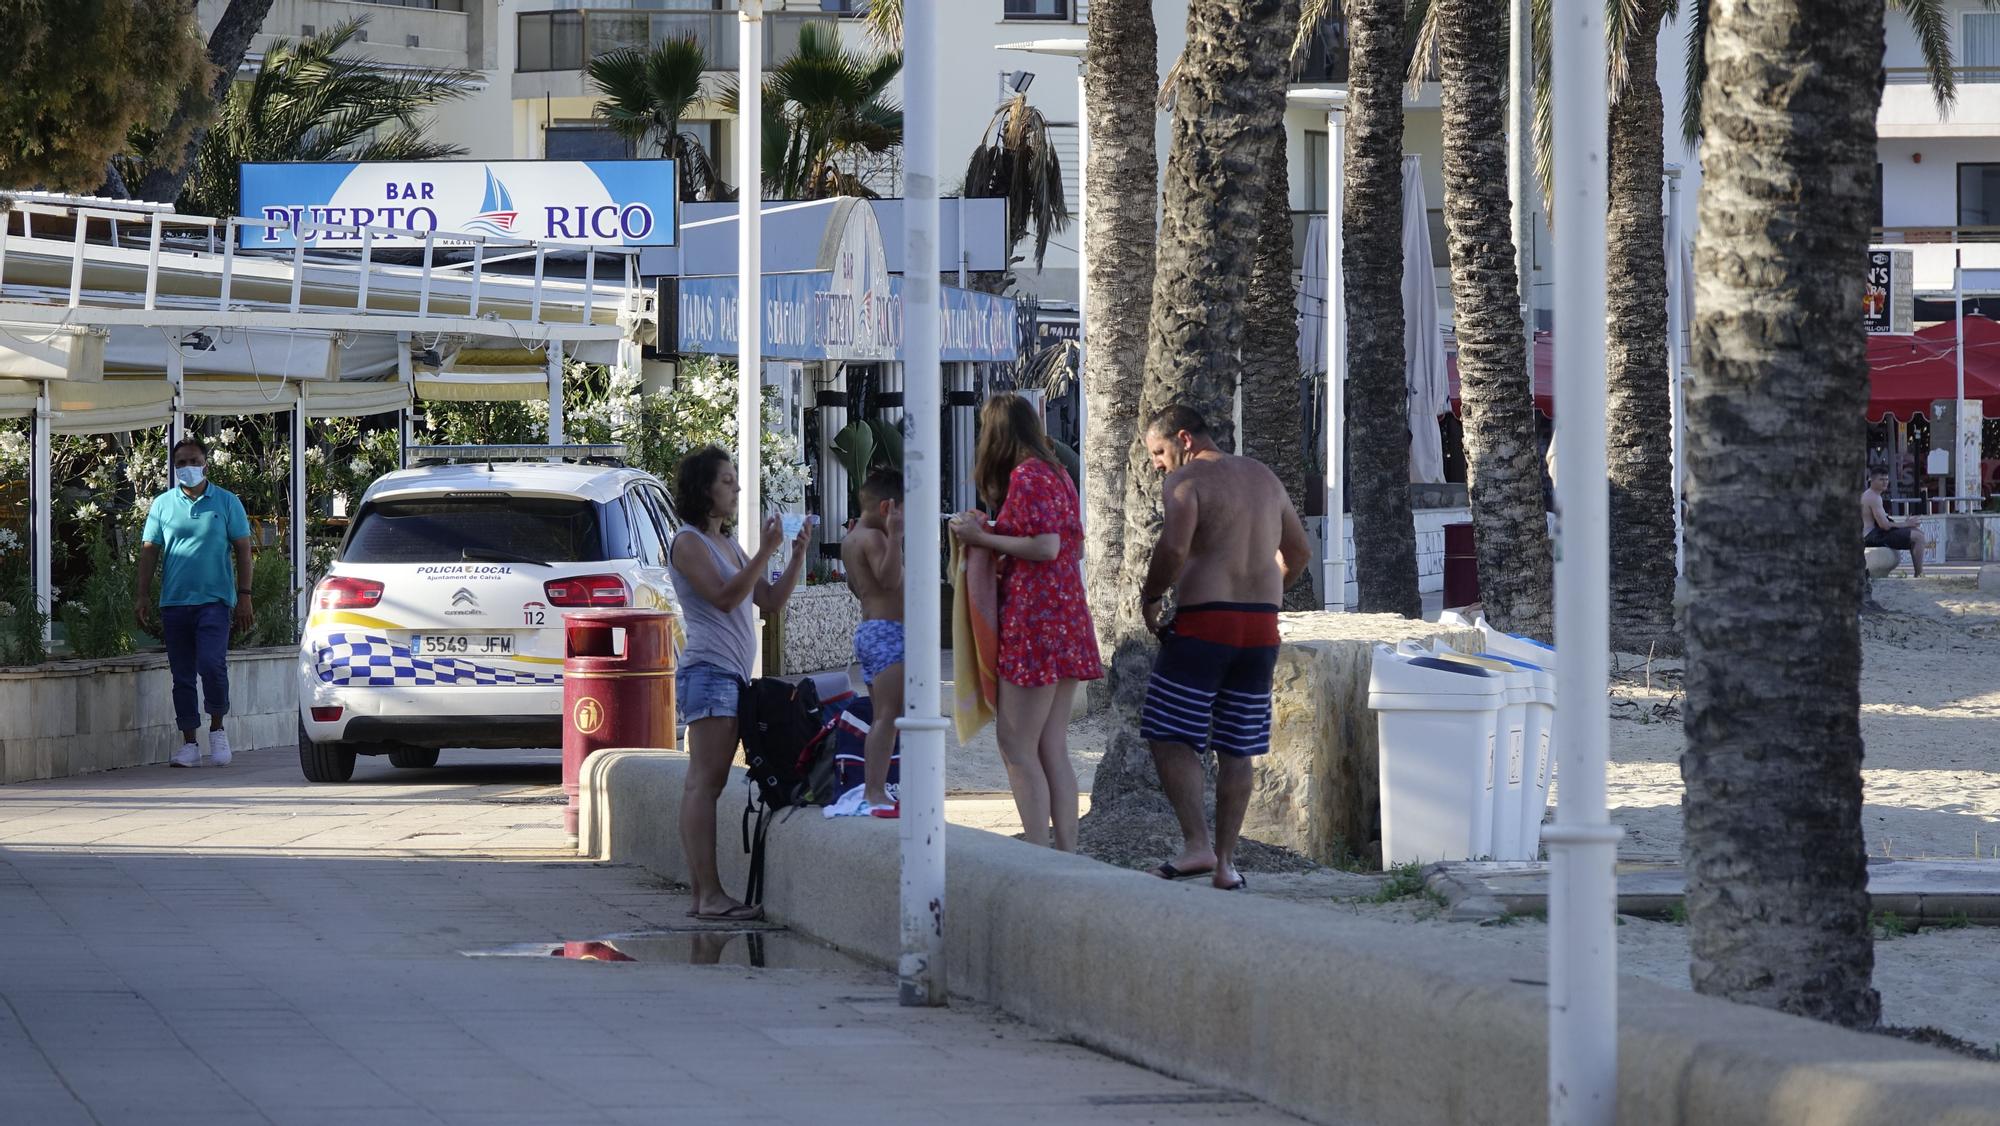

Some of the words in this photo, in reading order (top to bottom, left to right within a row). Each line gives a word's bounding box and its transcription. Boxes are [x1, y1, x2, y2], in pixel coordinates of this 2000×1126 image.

[386, 182, 435, 200] BAR
[262, 206, 438, 242] PUERTO
[543, 204, 653, 240] RICO
[843, 252, 854, 280] BAR
[682, 293, 714, 342] TAPAS
[720, 296, 739, 342] PAE
[768, 298, 806, 346] SEAFOOD
[814, 291, 855, 347] PUERTO
[876, 295, 902, 349] RICO
[416, 566, 463, 574] POLICIA
[474, 566, 512, 575] LOCAL
[523, 611, 545, 625] 112
[426, 636, 468, 653] 5549
[480, 637, 511, 653] JFM
